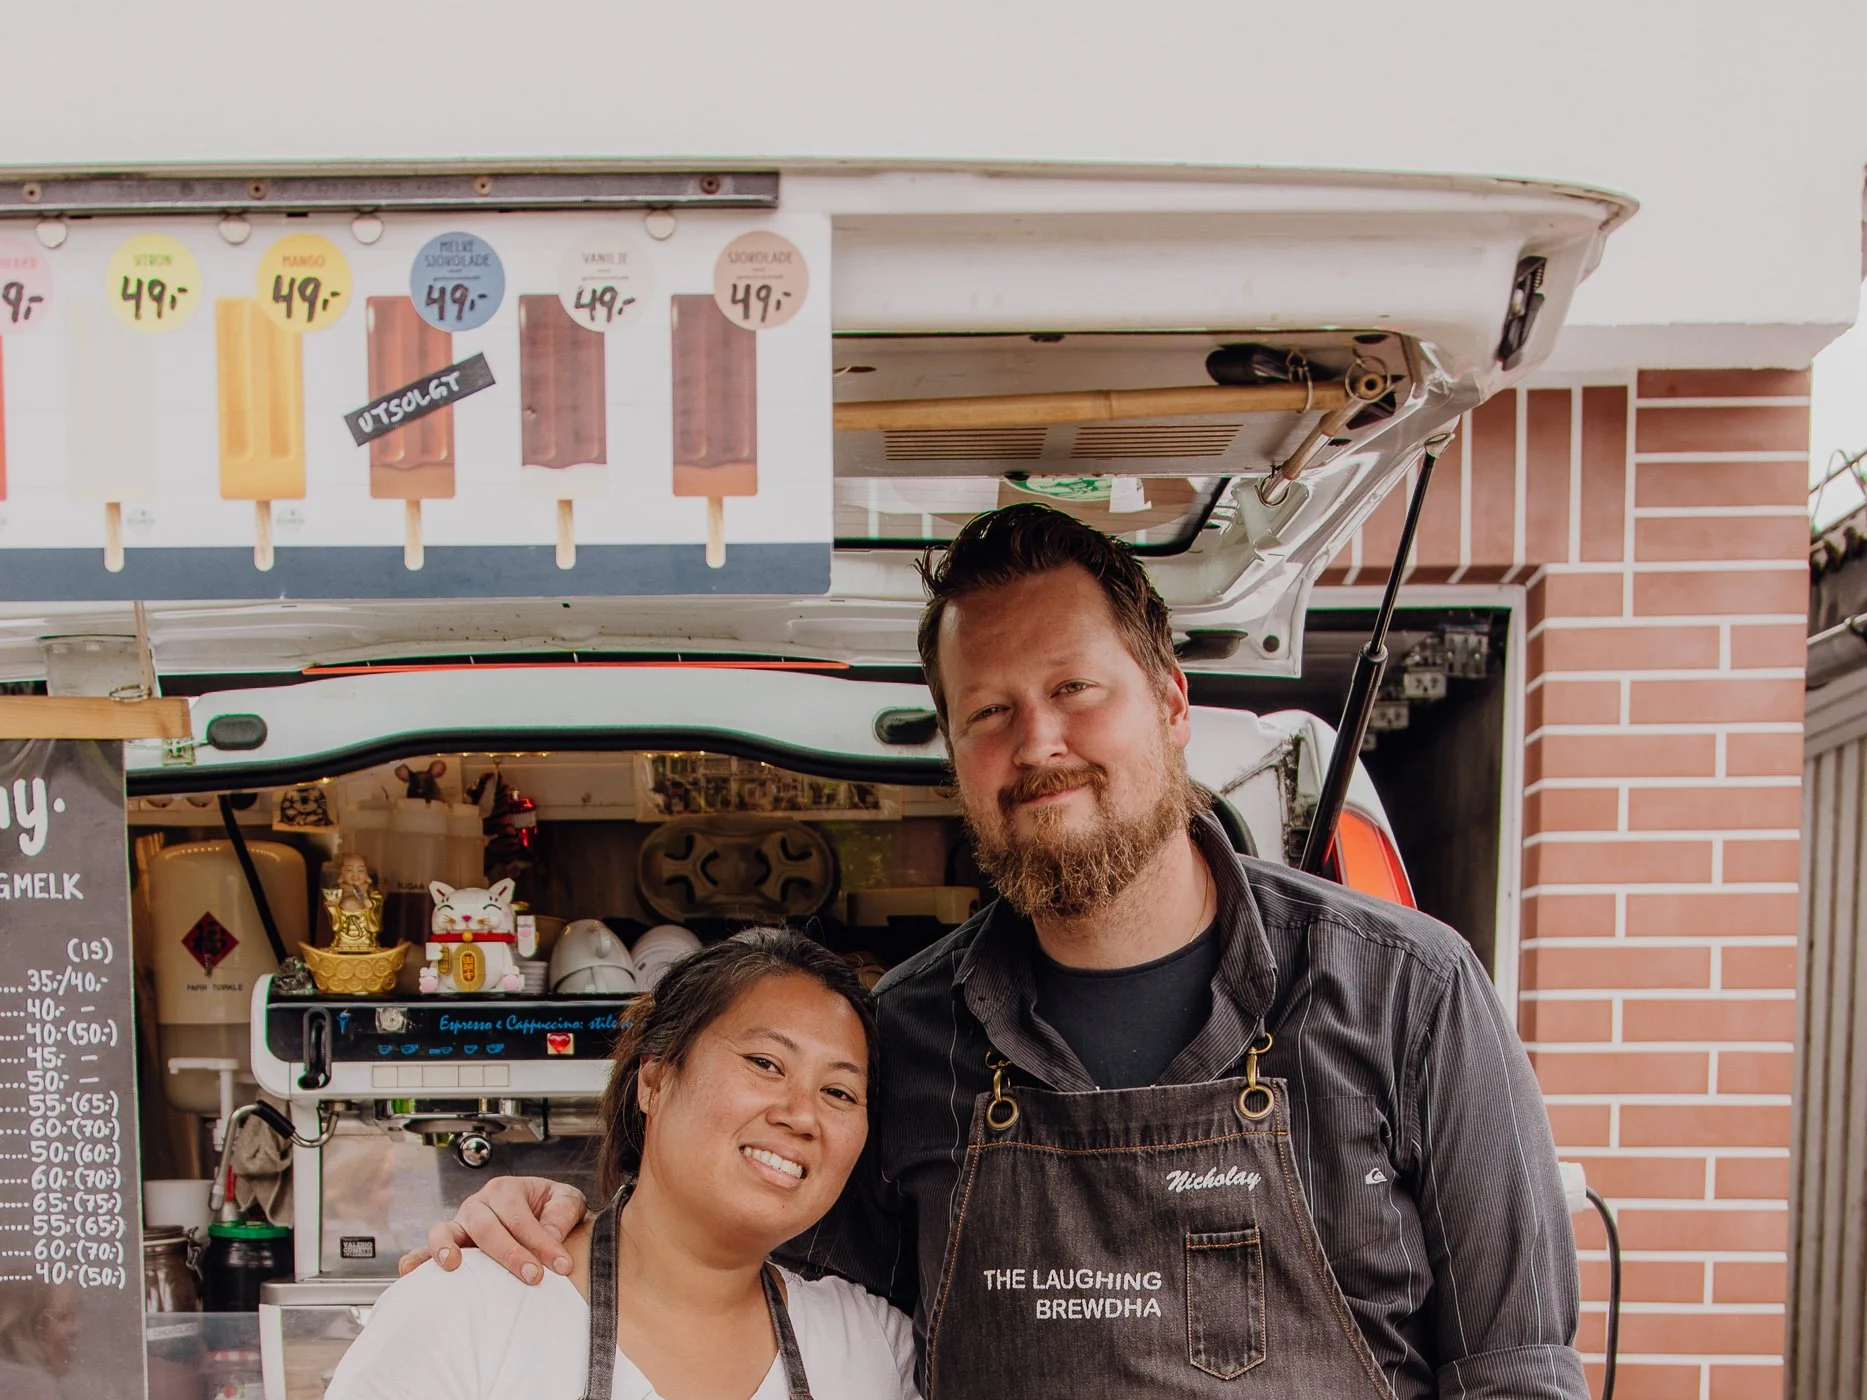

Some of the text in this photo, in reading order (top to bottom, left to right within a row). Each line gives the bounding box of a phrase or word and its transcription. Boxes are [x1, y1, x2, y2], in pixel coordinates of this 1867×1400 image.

[282, 255, 326, 267] MANGO
[582, 252, 629, 265] VANILJE
[727, 252, 793, 265] SJOKOLADE
[357, 371, 460, 435] UTSOLGT
[440, 1014, 493, 1035] Espresso
[505, 1014, 583, 1035] Cappuccino:
[1166, 1166, 1262, 1194] Nicholay
[983, 1268, 1163, 1291] THE LAUGHING
[1036, 1298, 1162, 1320] BREWDHA
